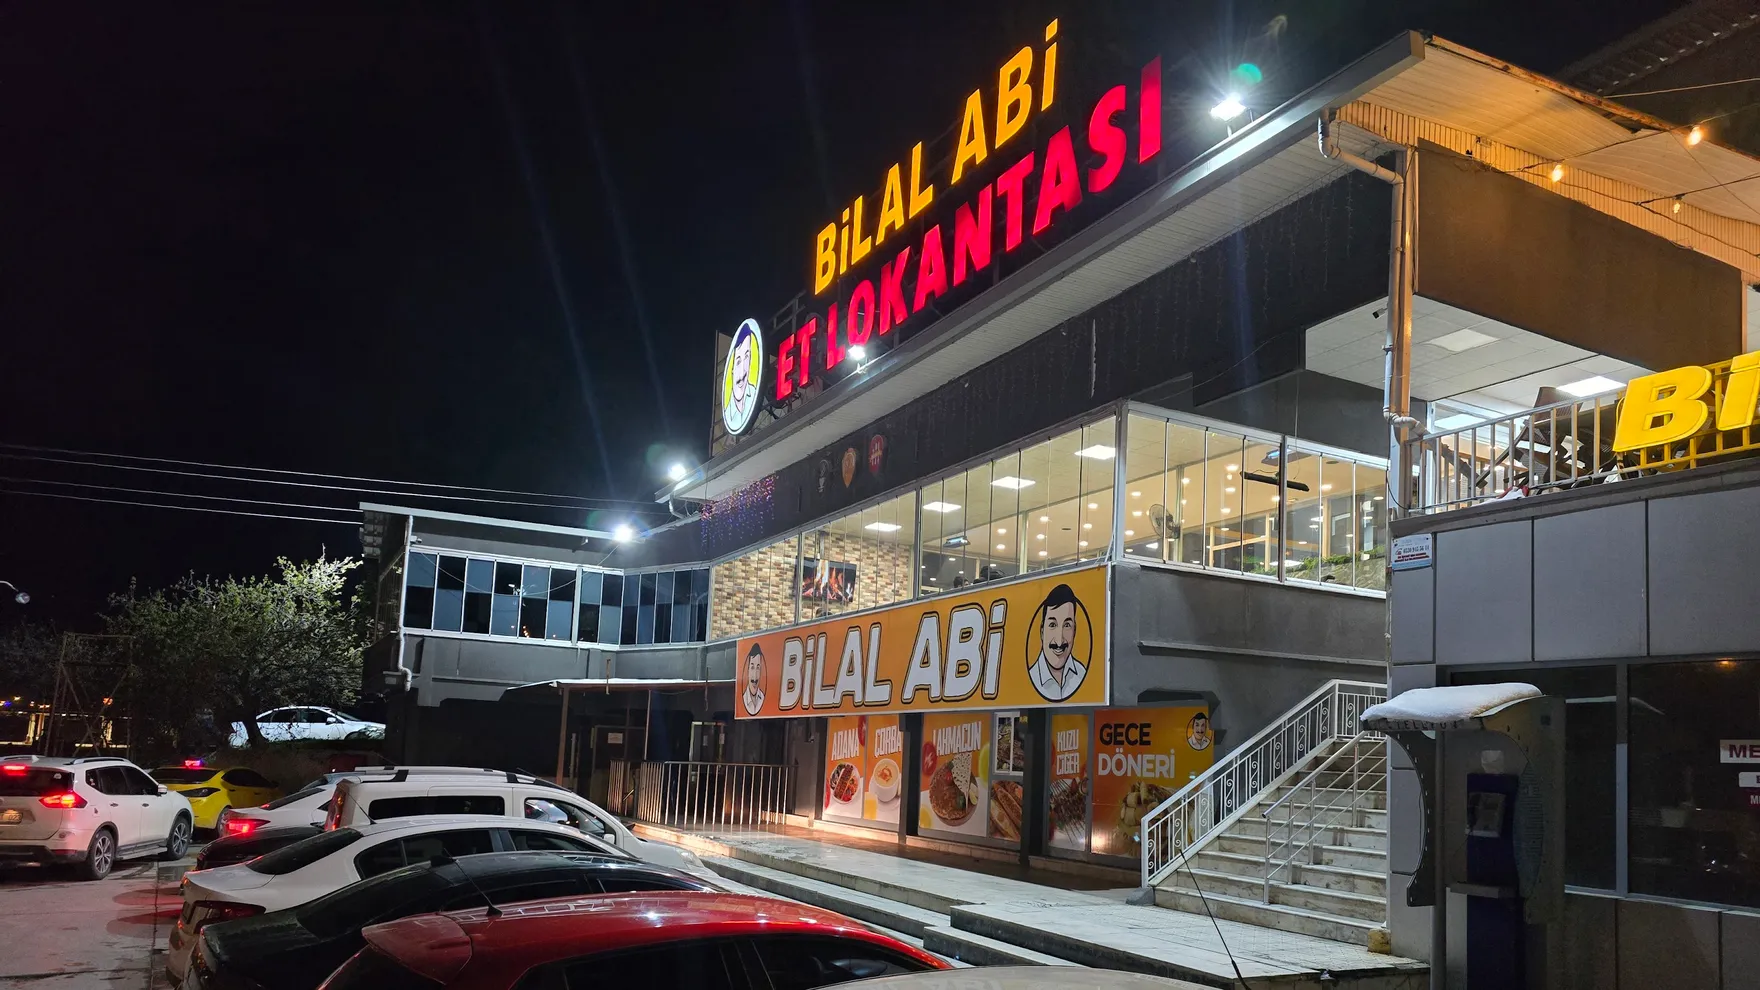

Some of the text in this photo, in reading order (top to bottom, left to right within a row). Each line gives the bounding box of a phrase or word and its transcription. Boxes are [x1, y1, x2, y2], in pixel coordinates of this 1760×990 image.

[776, 55, 1162, 401] ET LOKANTASI
[831, 727, 860, 761] ADANA
[874, 724, 902, 758] ÇORBA
[1056, 729, 1080, 752] KUZU
[1100, 723, 1151, 746] GECE
[1098, 747, 1175, 778] DÖNERİ
